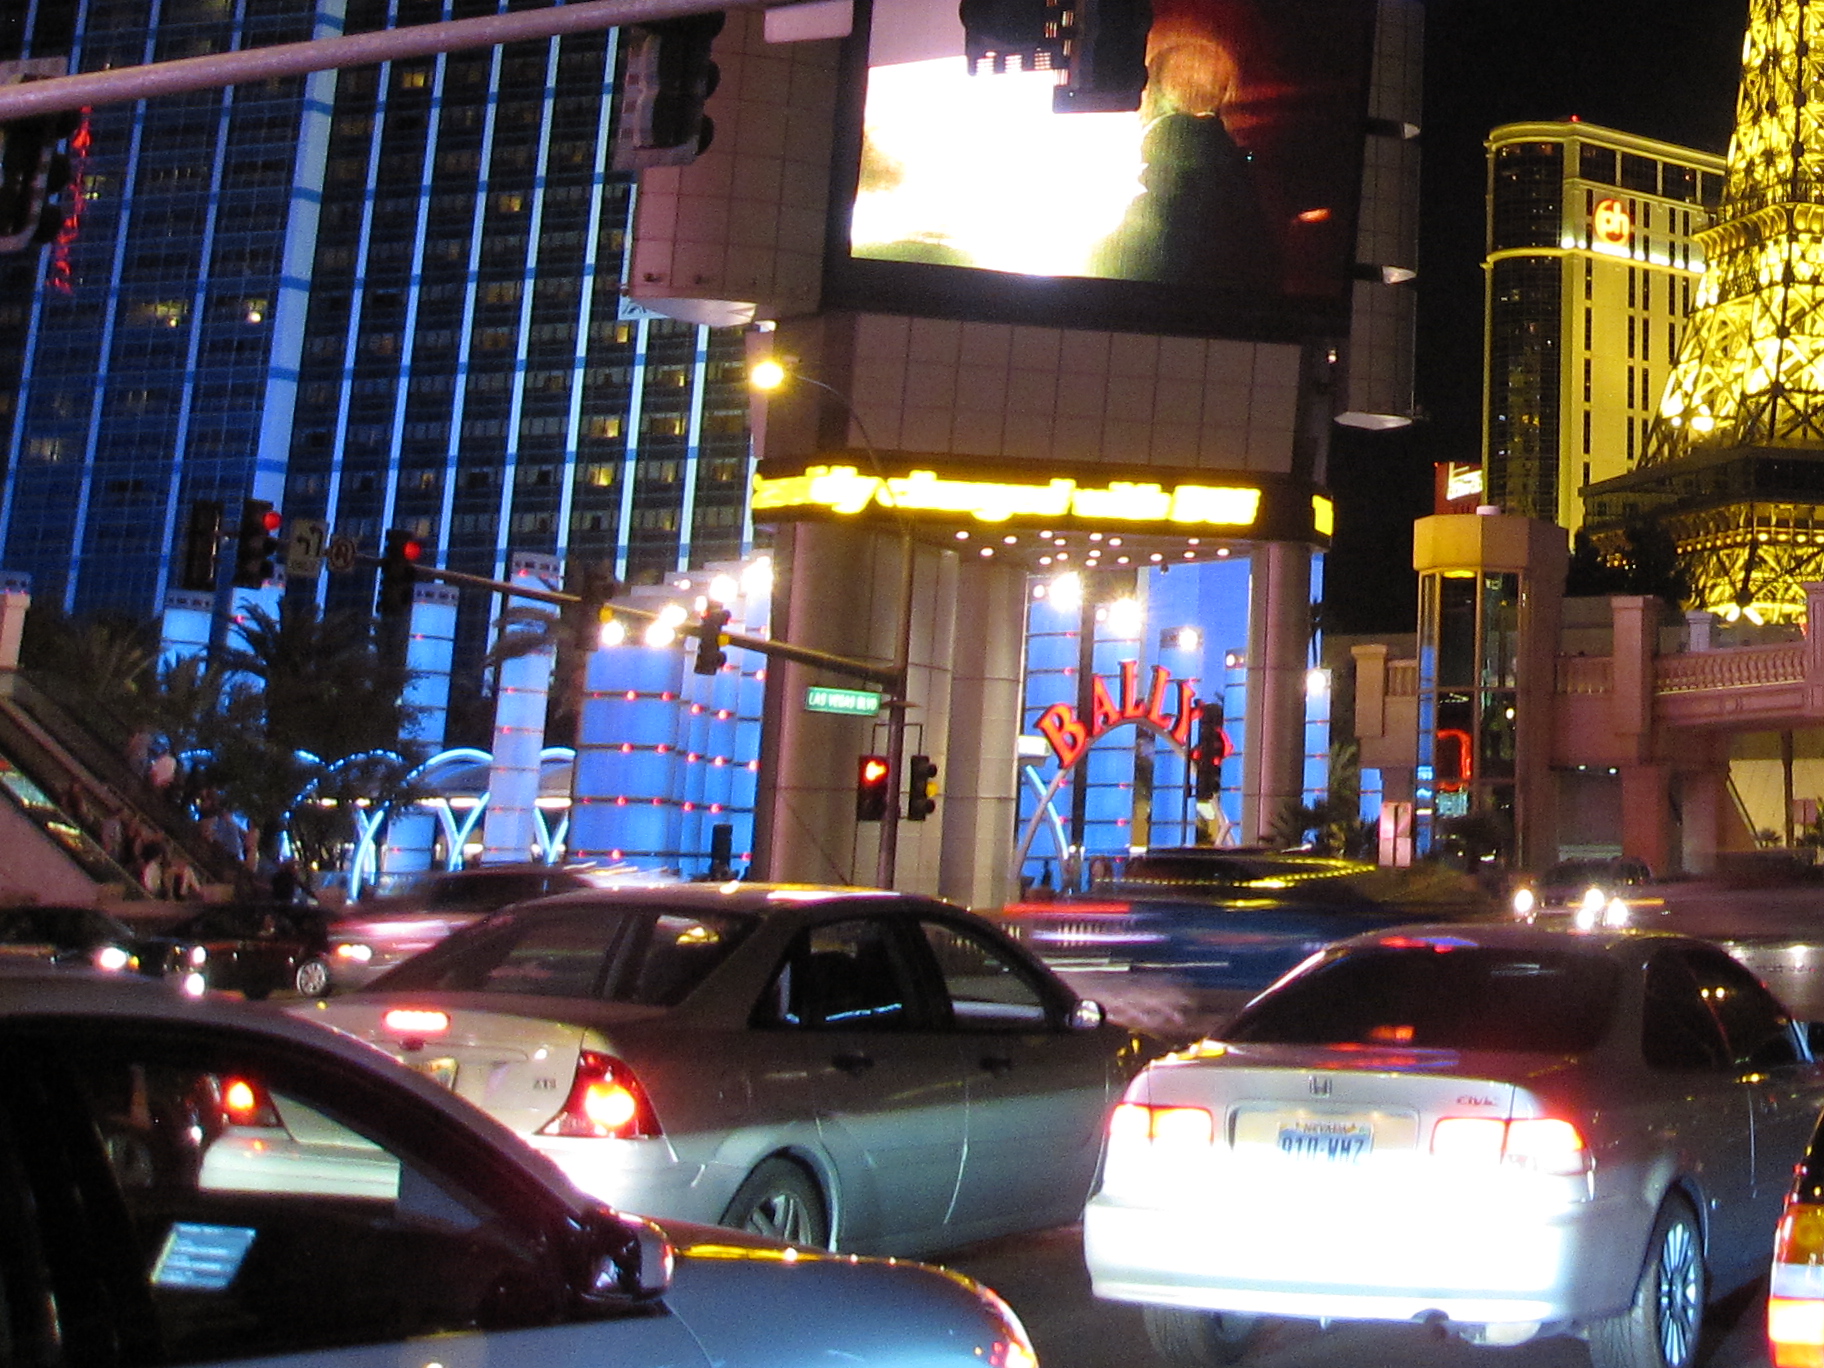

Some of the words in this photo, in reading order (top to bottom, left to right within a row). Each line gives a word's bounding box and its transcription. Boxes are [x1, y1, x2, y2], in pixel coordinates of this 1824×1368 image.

[808, 692, 827, 707] LAS
[828, 693, 855, 710] VEGAS
[856, 696, 878, 712] BLVD
